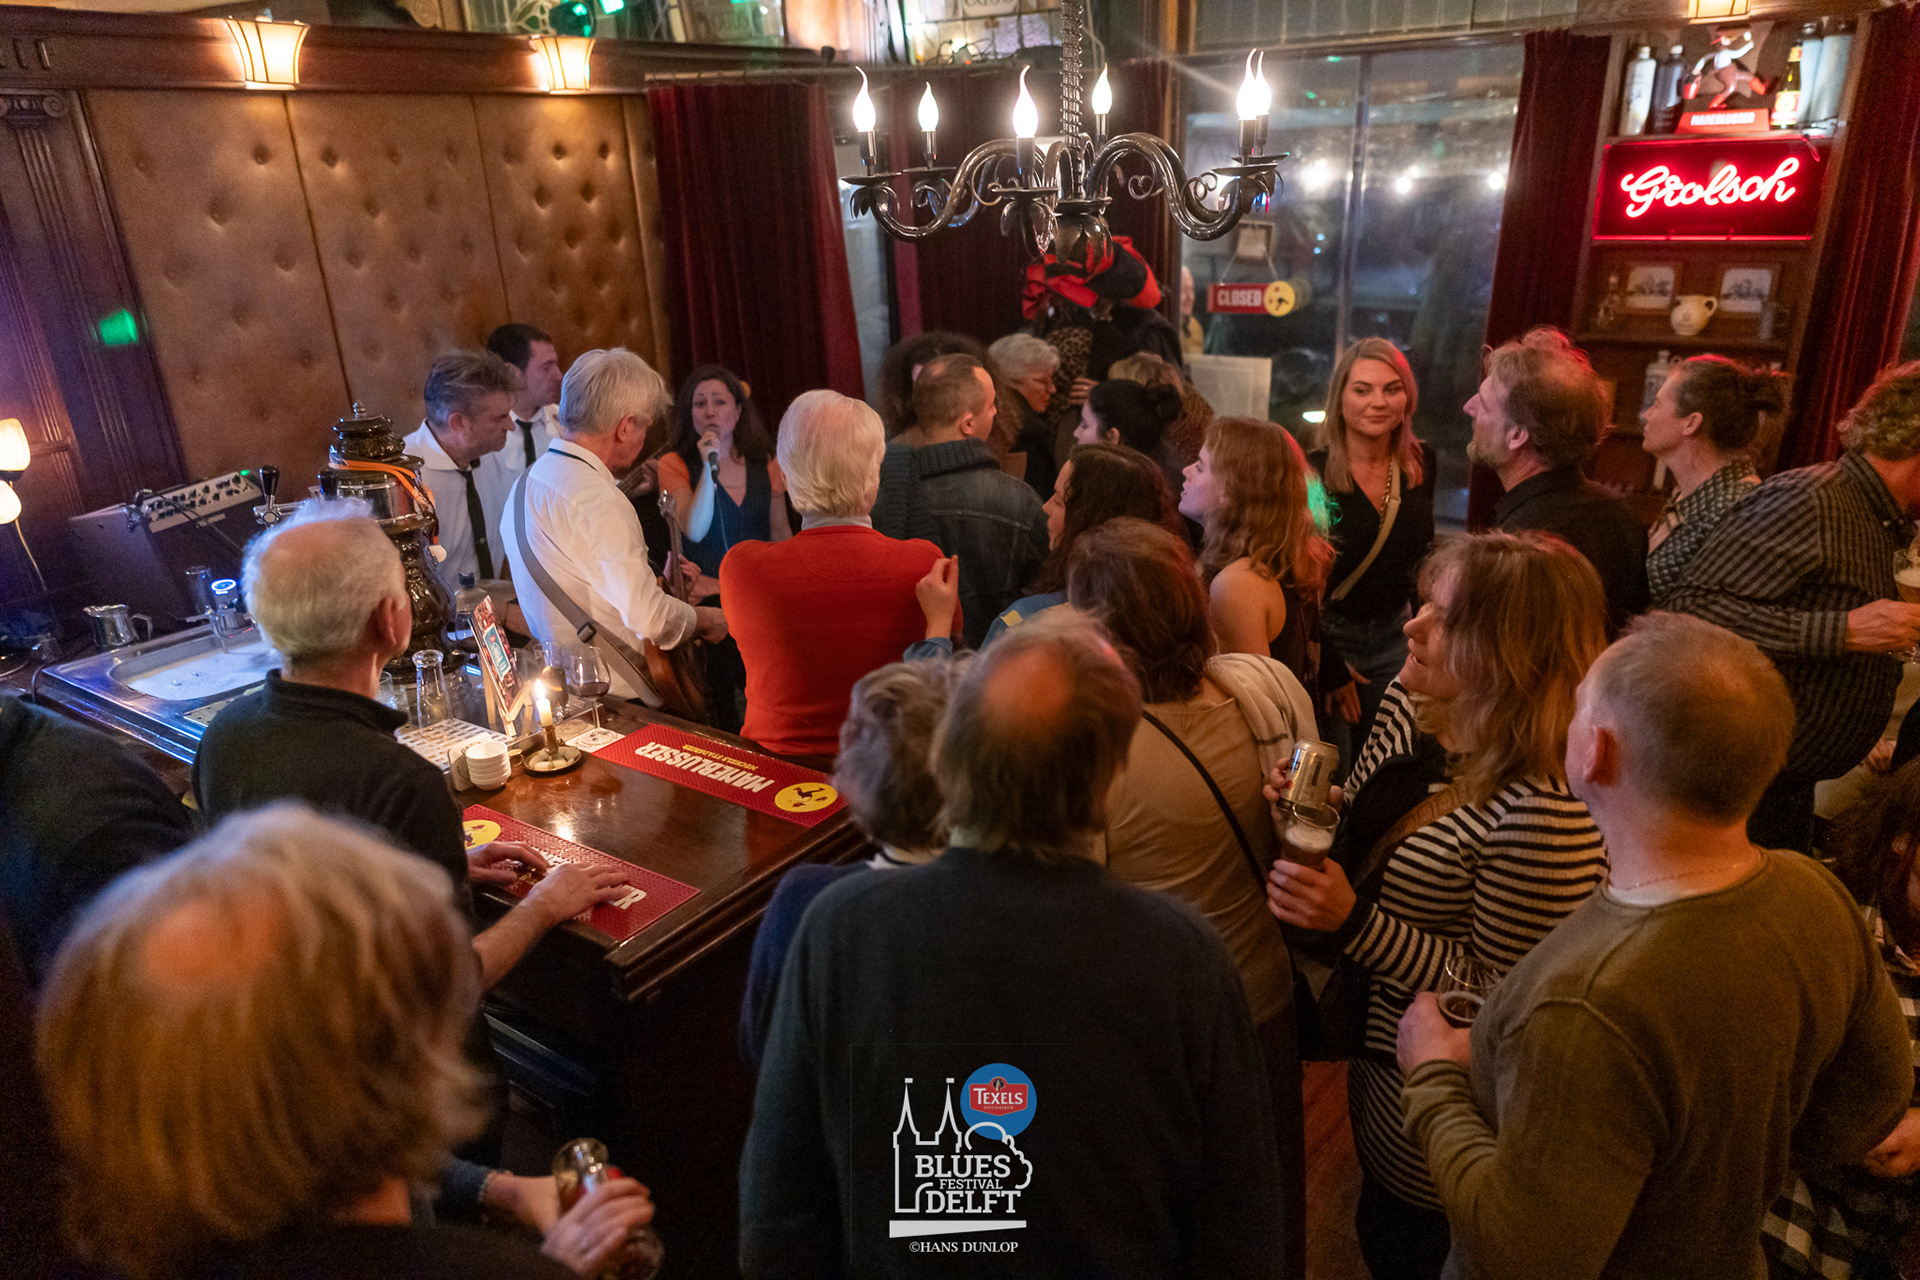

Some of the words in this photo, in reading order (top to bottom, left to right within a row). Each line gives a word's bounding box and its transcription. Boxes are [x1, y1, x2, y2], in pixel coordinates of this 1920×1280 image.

[1620, 157, 1800, 218] Grolsch
[1217, 289, 1263, 307] CLOSED
[634, 741, 775, 793] MANEBLUSSER
